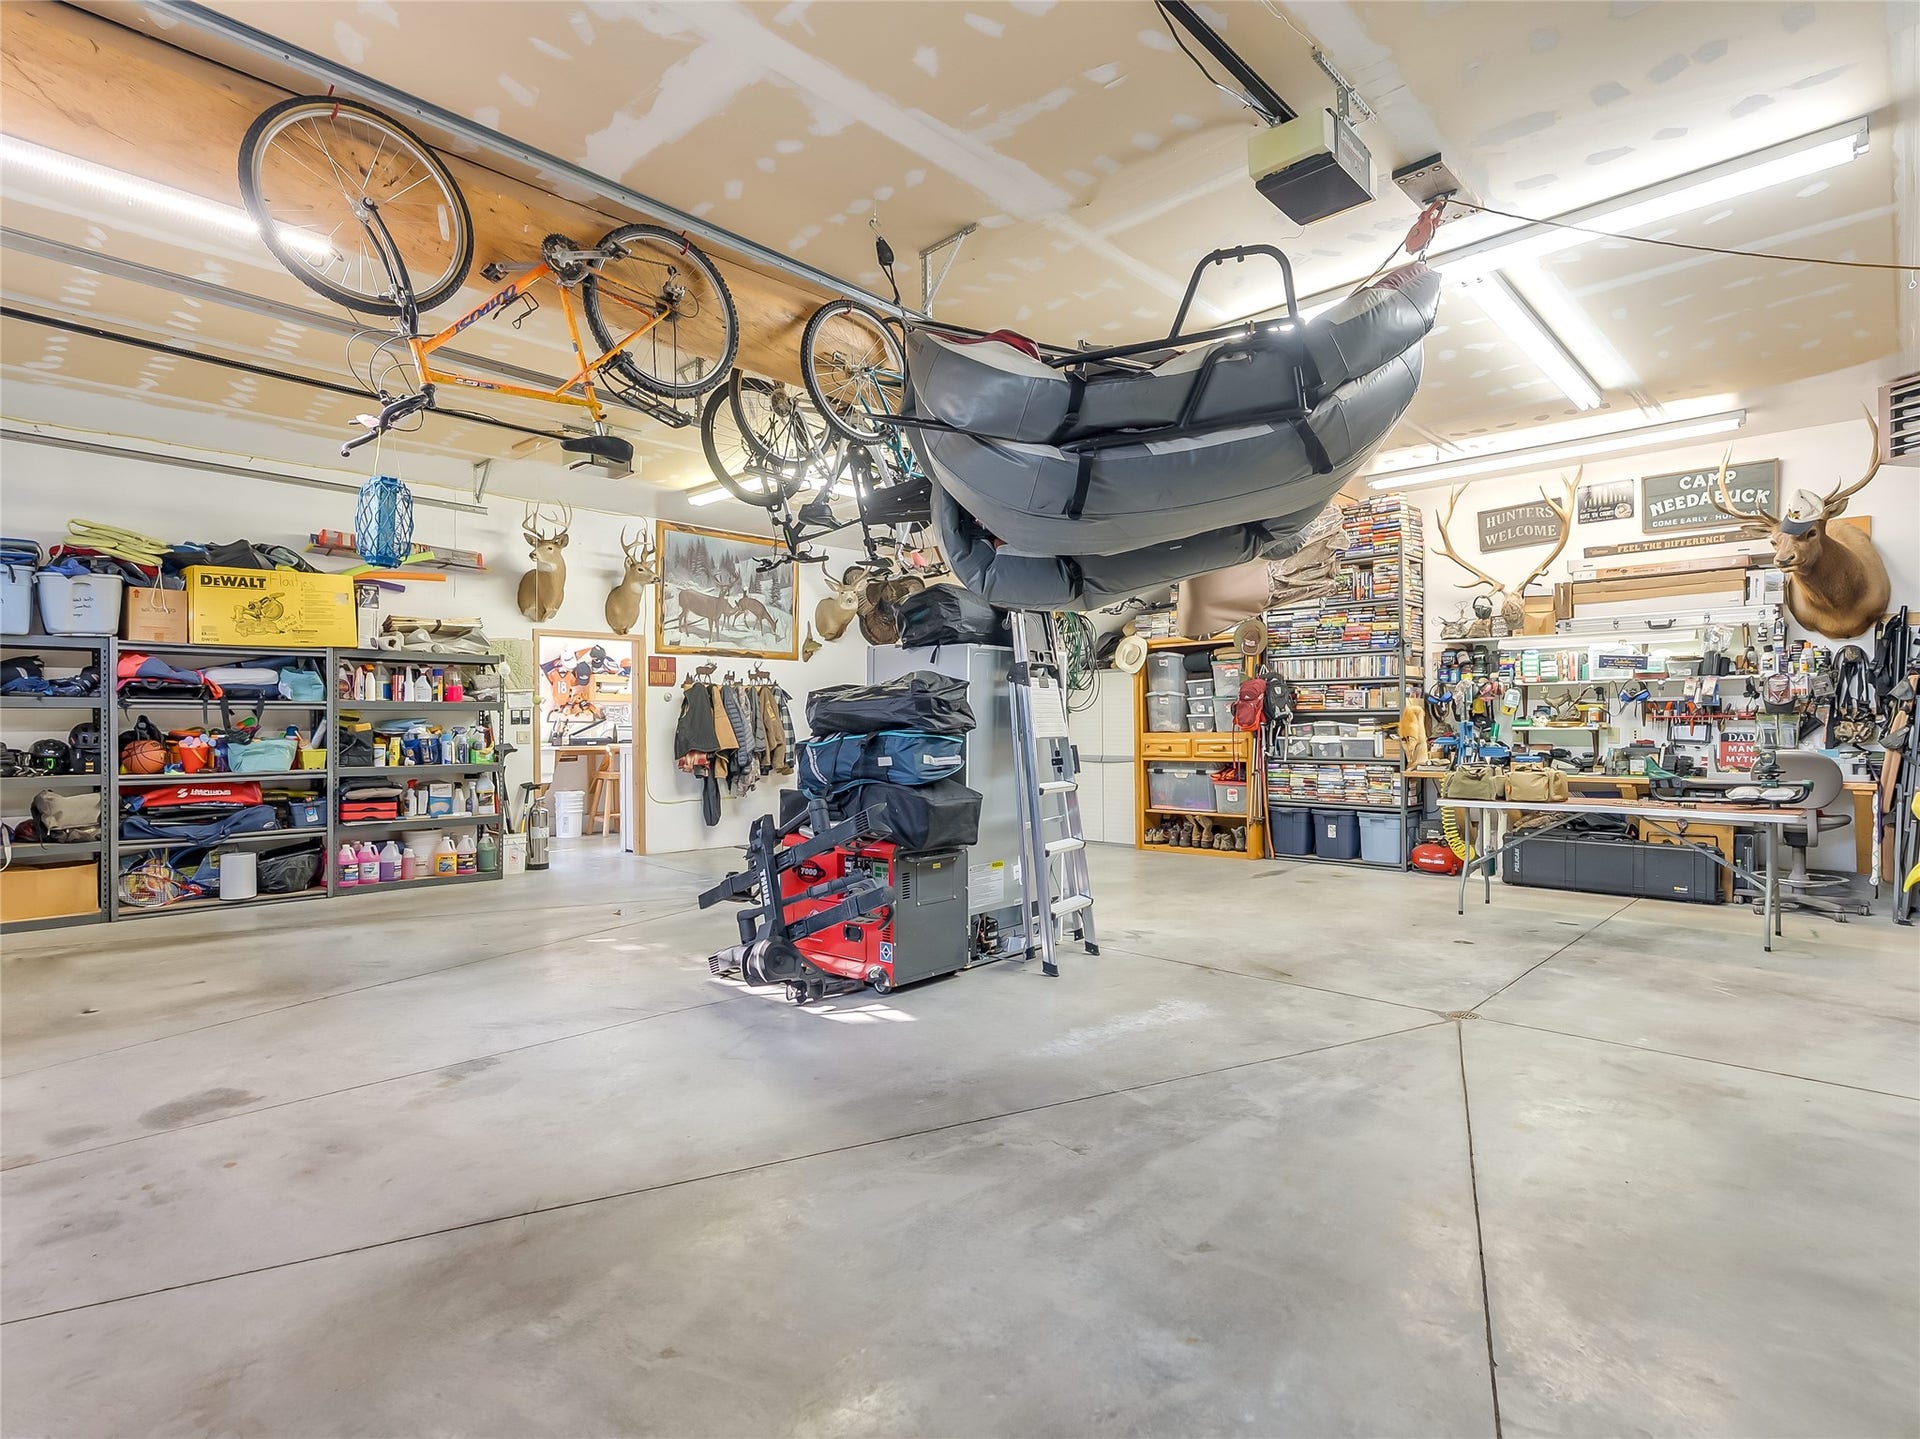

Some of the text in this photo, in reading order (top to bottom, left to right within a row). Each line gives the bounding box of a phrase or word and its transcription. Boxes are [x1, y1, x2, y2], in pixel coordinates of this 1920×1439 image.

[1679, 470, 1737, 490] CAMP
[1649, 489, 1770, 517] NEEDABUCK
[1486, 505, 1555, 529] HUNTERS
[1652, 518, 1681, 528] COME
[1680, 515, 1708, 524] EARLY
[1485, 524, 1557, 546] WELCOME
[1617, 543, 1640, 553] FEEL
[1643, 541, 1662, 550] THE
[1664, 535, 1726, 548] DIFFERENCE
[659, 658, 668, 671] NO
[650, 671, 676, 684] HUNTING
[557, 681, 568, 694] 18
[1728, 733, 1755, 742] DAD
[1728, 745, 1754, 753] MAN
[800, 867, 818, 876] 7000
[759, 868, 771, 907] THULE
